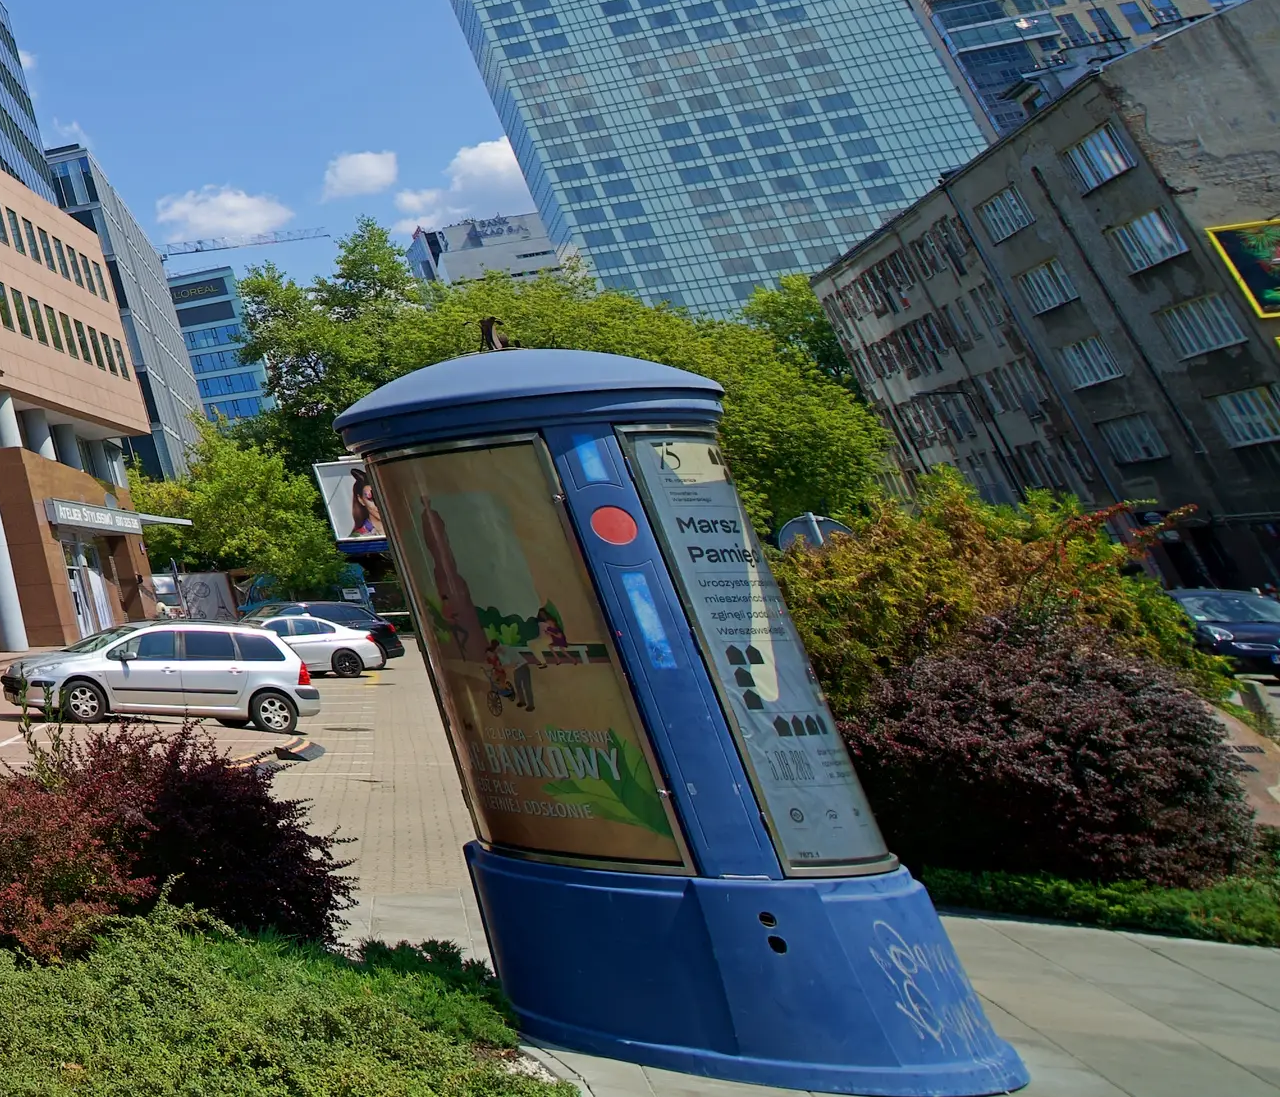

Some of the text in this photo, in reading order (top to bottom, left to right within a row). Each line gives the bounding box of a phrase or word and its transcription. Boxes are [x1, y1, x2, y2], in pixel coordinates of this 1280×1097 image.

[675, 516, 741, 534] Marsz
[697, 579, 750, 589] Uroczyste
[711, 609, 746, 621] zginęli
[498, 729, 528, 741] LIPCA
[545, 728, 614, 744] WRZEŚNIA
[485, 742, 621, 781] BANKOWY
[493, 779, 519, 796] PLAC
[524, 799, 594, 820] ODSŁONIE
